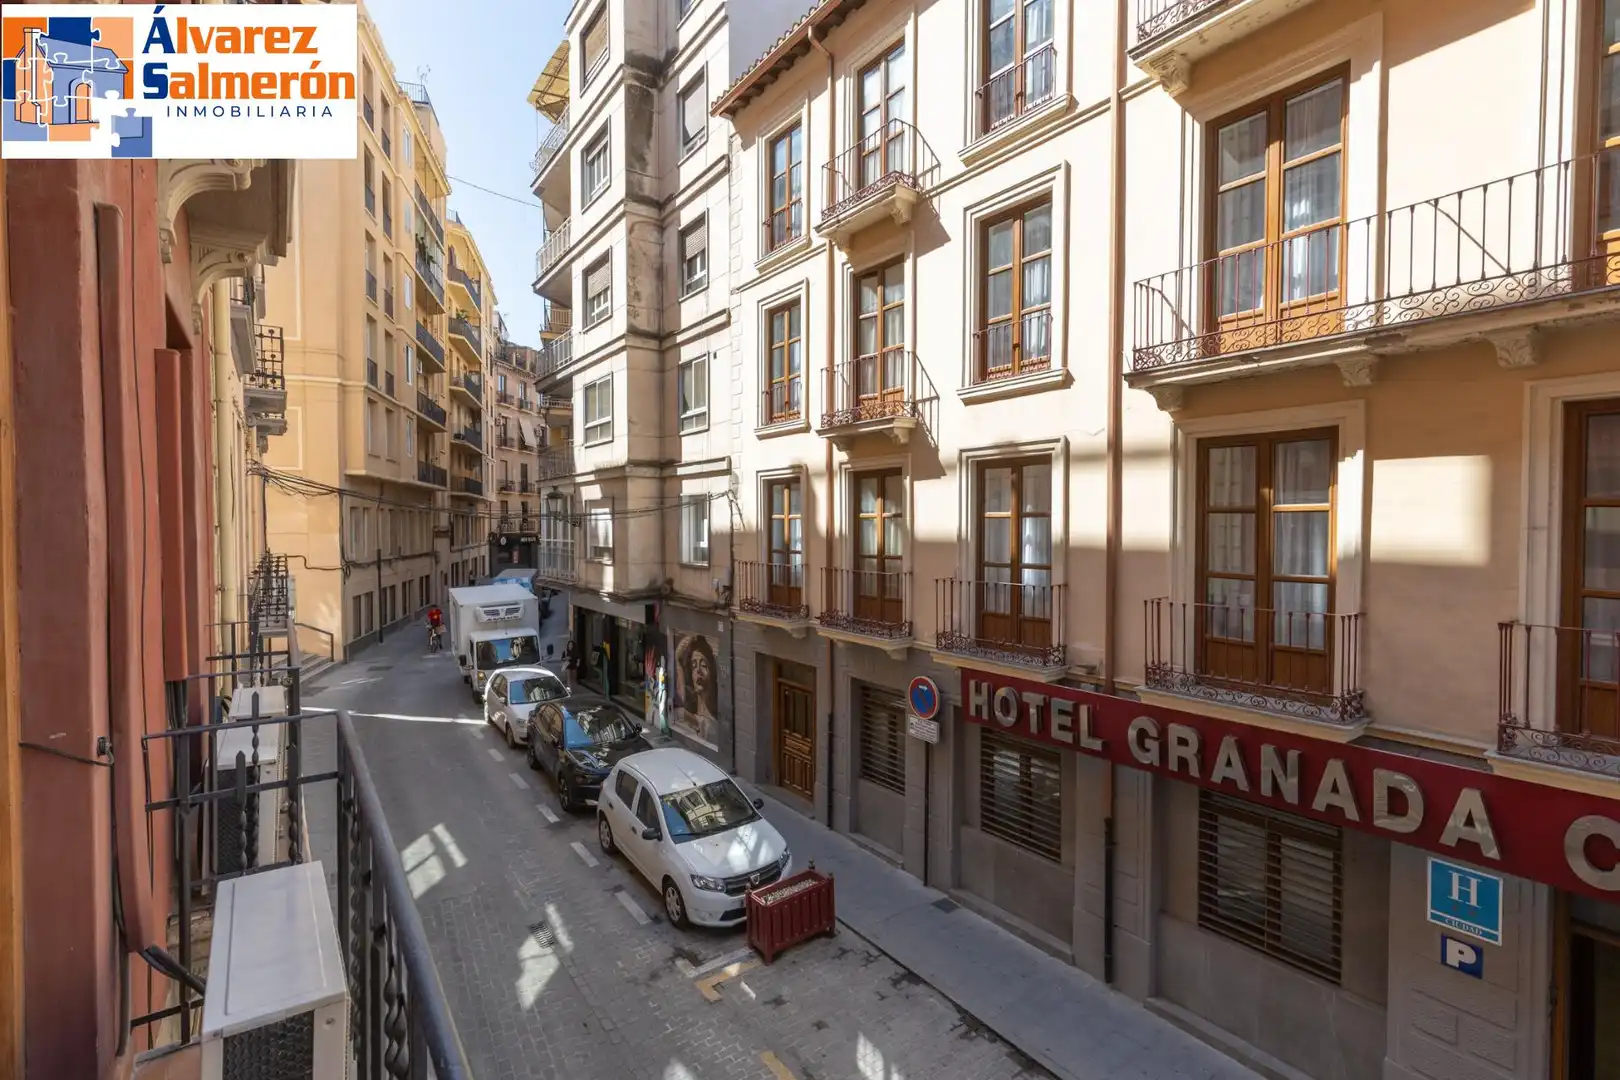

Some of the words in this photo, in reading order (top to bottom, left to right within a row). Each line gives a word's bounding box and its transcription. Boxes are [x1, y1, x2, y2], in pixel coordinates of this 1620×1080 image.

[969, 679, 1105, 750] HOTEL
[1127, 716, 1501, 860] GRANADA
[1447, 870, 1482, 908] H
[1446, 937, 1477, 968] P
